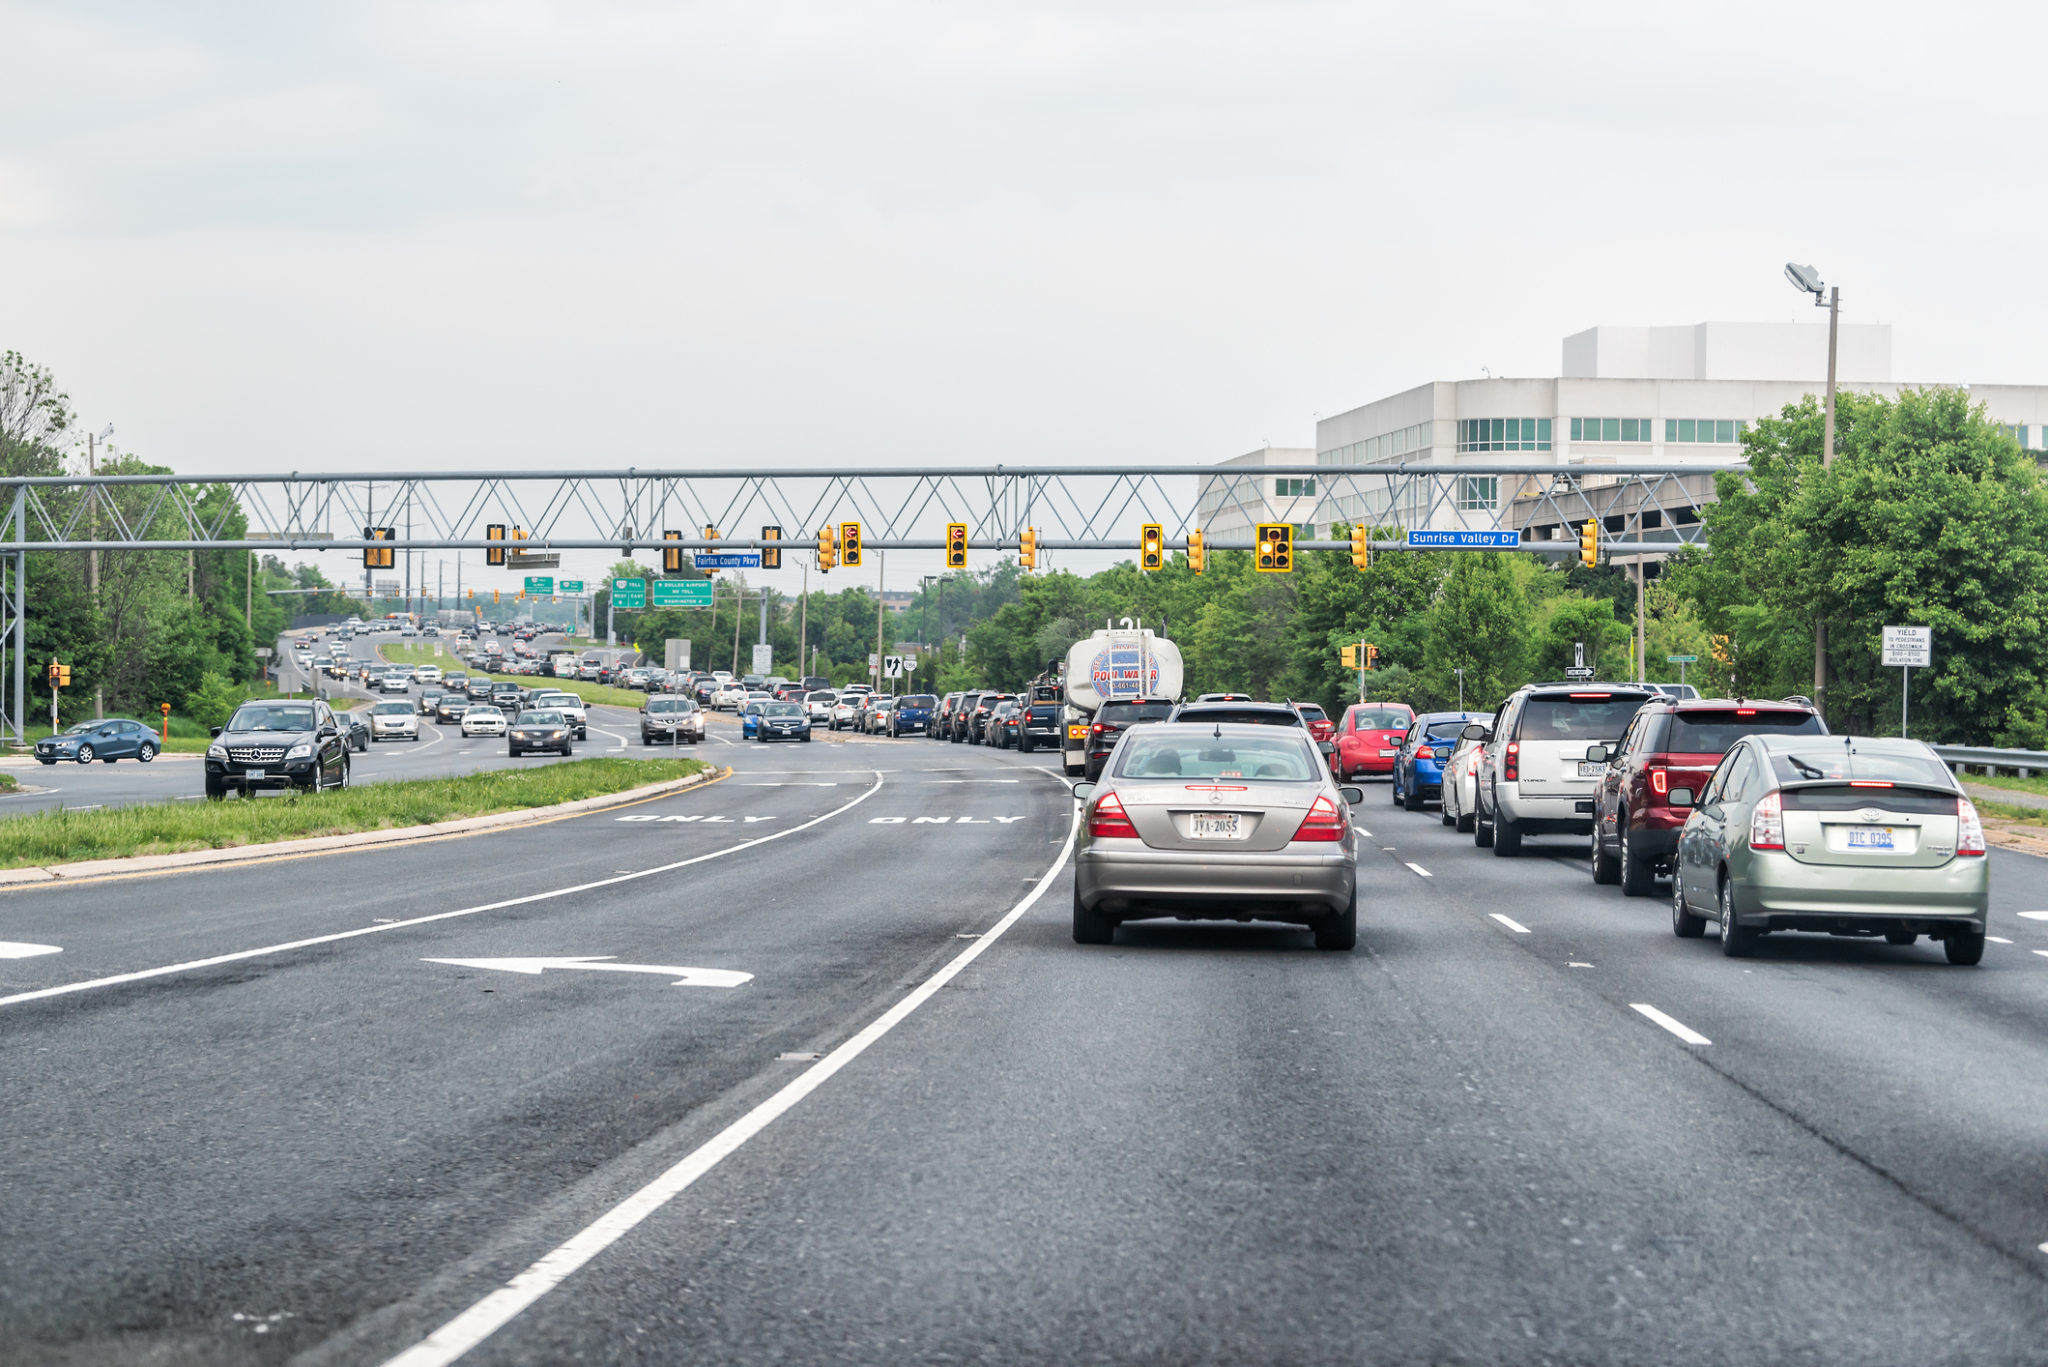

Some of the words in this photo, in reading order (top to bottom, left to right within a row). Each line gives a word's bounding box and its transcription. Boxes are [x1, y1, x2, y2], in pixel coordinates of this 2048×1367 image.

[1412, 533, 1455, 543] Sunrise
[1460, 533, 1496, 545] Valley
[1501, 533, 1515, 543] Dr
[697, 557, 717, 565] Fairfax
[719, 557, 741, 567] County
[742, 557, 759, 567] Pkwy
[614, 815, 777, 823] ONLY
[867, 816, 1026, 824] ONLY
[1194, 820, 1238, 832] JVA-2055
[1870, 832, 1892, 844] 0395
